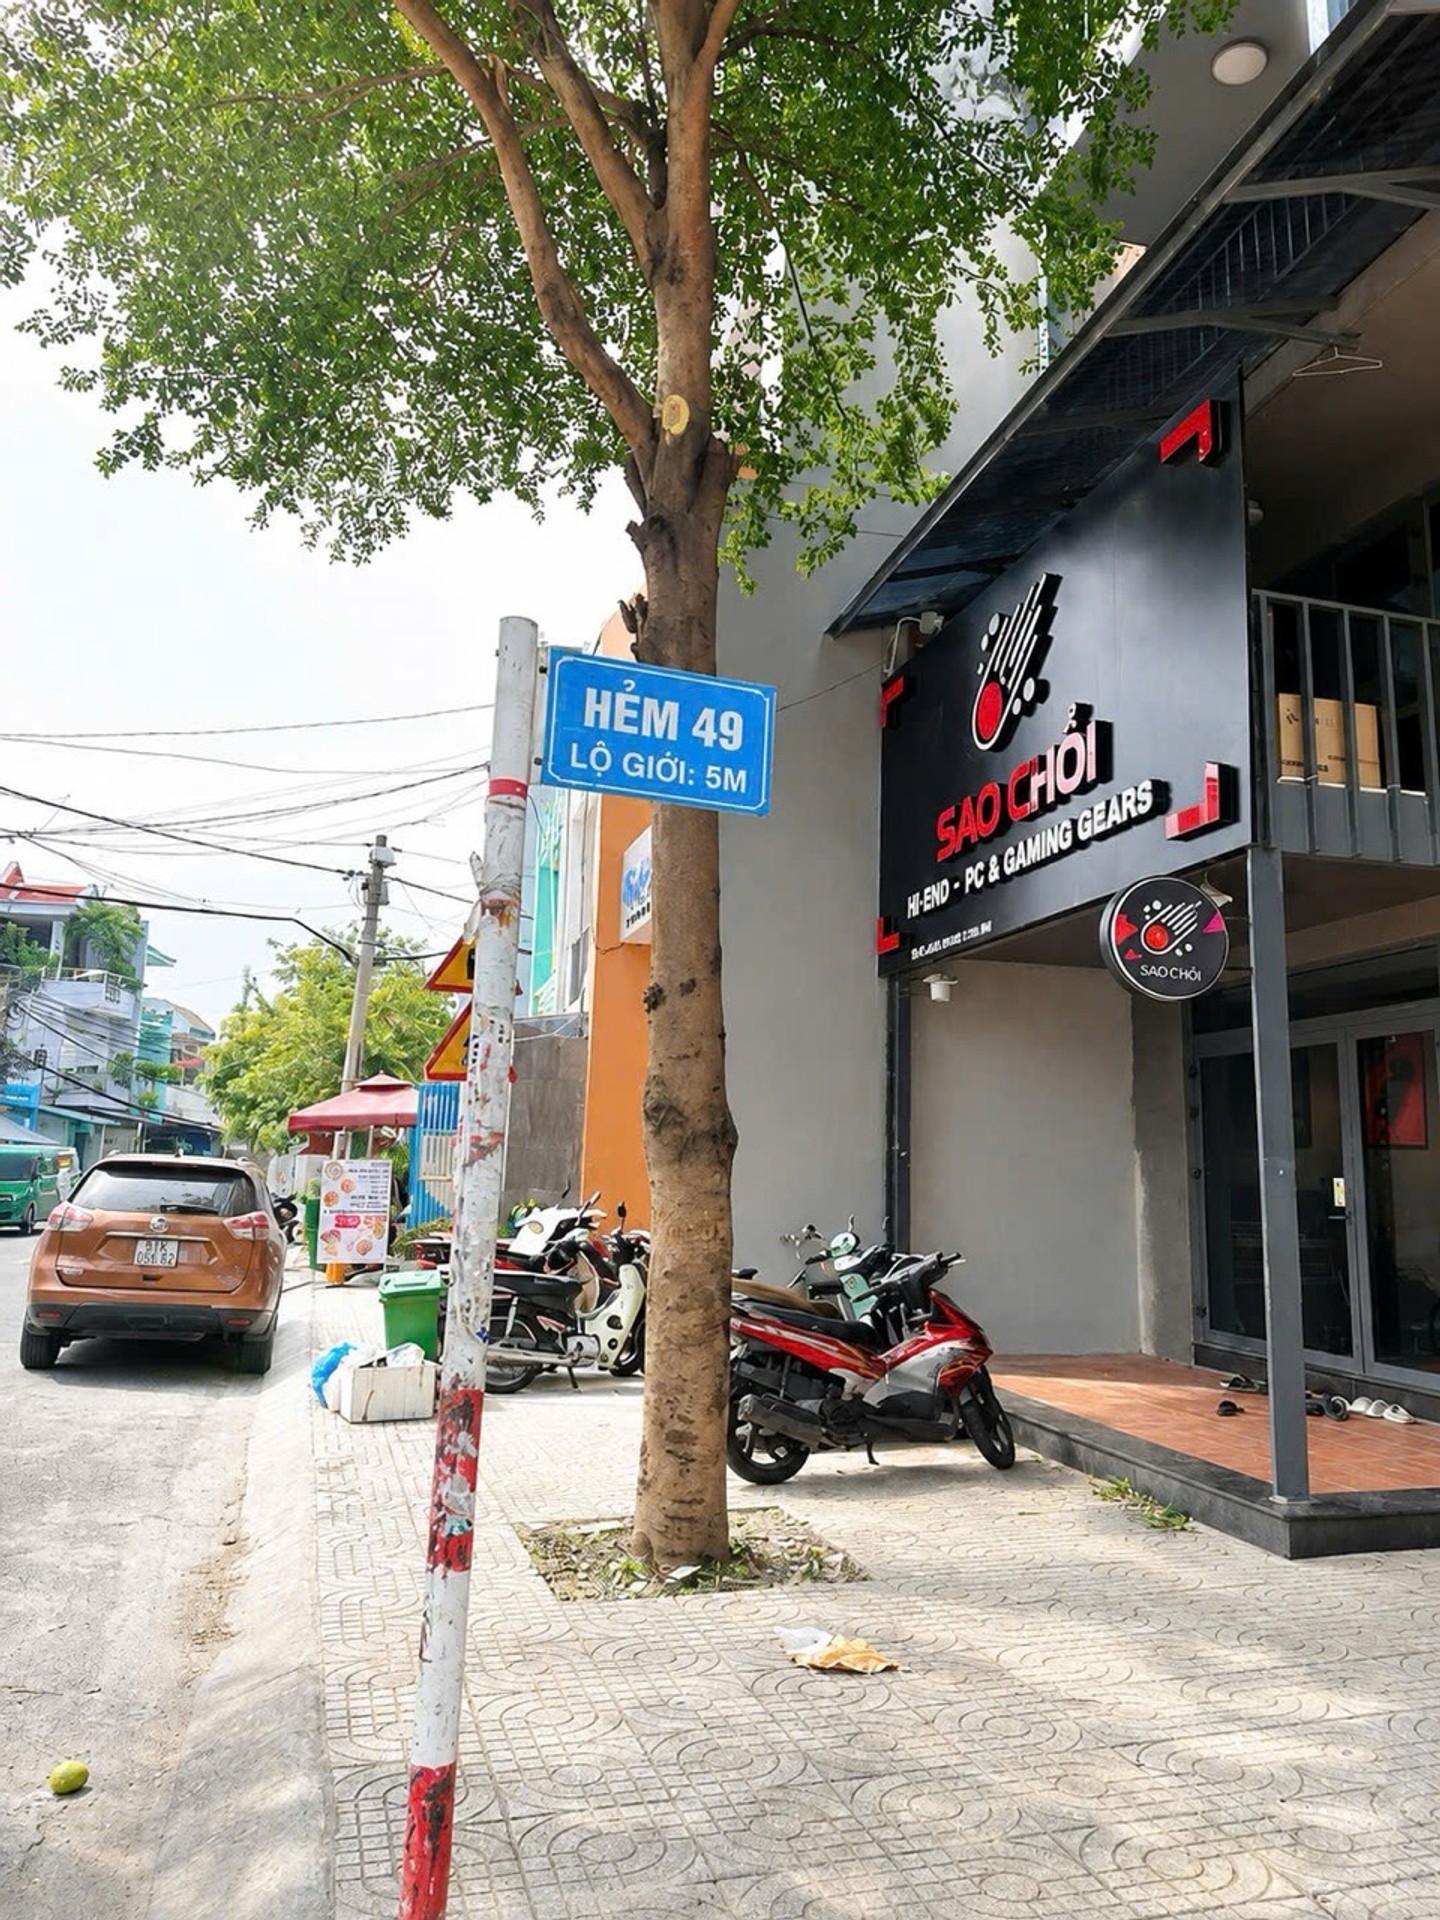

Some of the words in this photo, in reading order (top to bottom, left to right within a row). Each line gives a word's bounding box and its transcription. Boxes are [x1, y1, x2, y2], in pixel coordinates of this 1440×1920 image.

[584, 679, 680, 741] HẺM
[691, 707, 744, 751] 49
[570, 741, 612, 777] LỘ
[622, 751, 696, 786] GIỚI:
[705, 765, 748, 794] 5M
[907, 878, 950, 919] HI-END
[965, 861, 985, 894] PC
[988, 854, 1000, 883] &
[1003, 820, 1073, 876] GAMING
[1077, 779, 1153, 841] GEARS
[936, 782, 1001, 863] SAO
[1140, 964, 1168, 978] SAO
